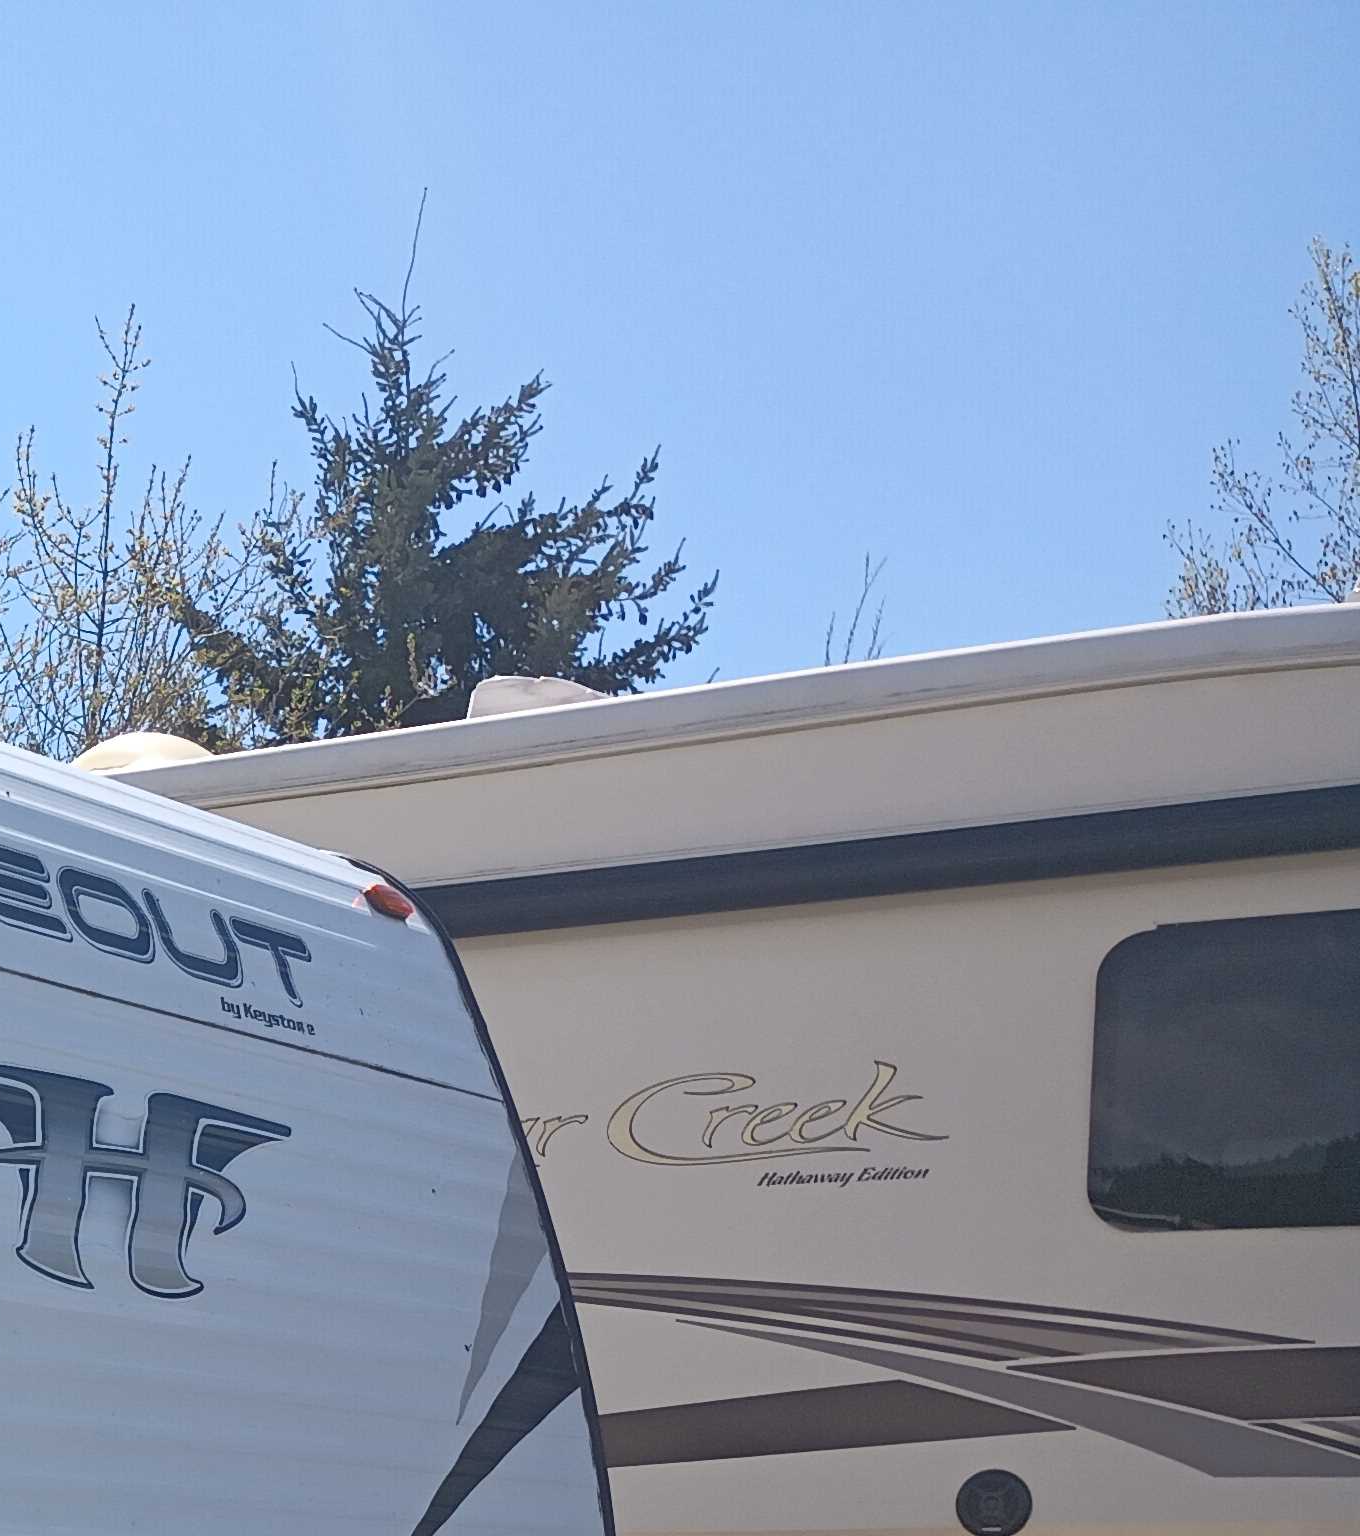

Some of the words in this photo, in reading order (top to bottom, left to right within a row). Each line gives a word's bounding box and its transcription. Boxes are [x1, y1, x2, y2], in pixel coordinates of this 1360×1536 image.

[220, 996, 242, 1019] by
[242, 1002, 316, 1036] Keystone
[606, 1059, 950, 1166] Creek
[757, 1170, 855, 1188] Hathaway
[856, 1166, 930, 1183] Edition
